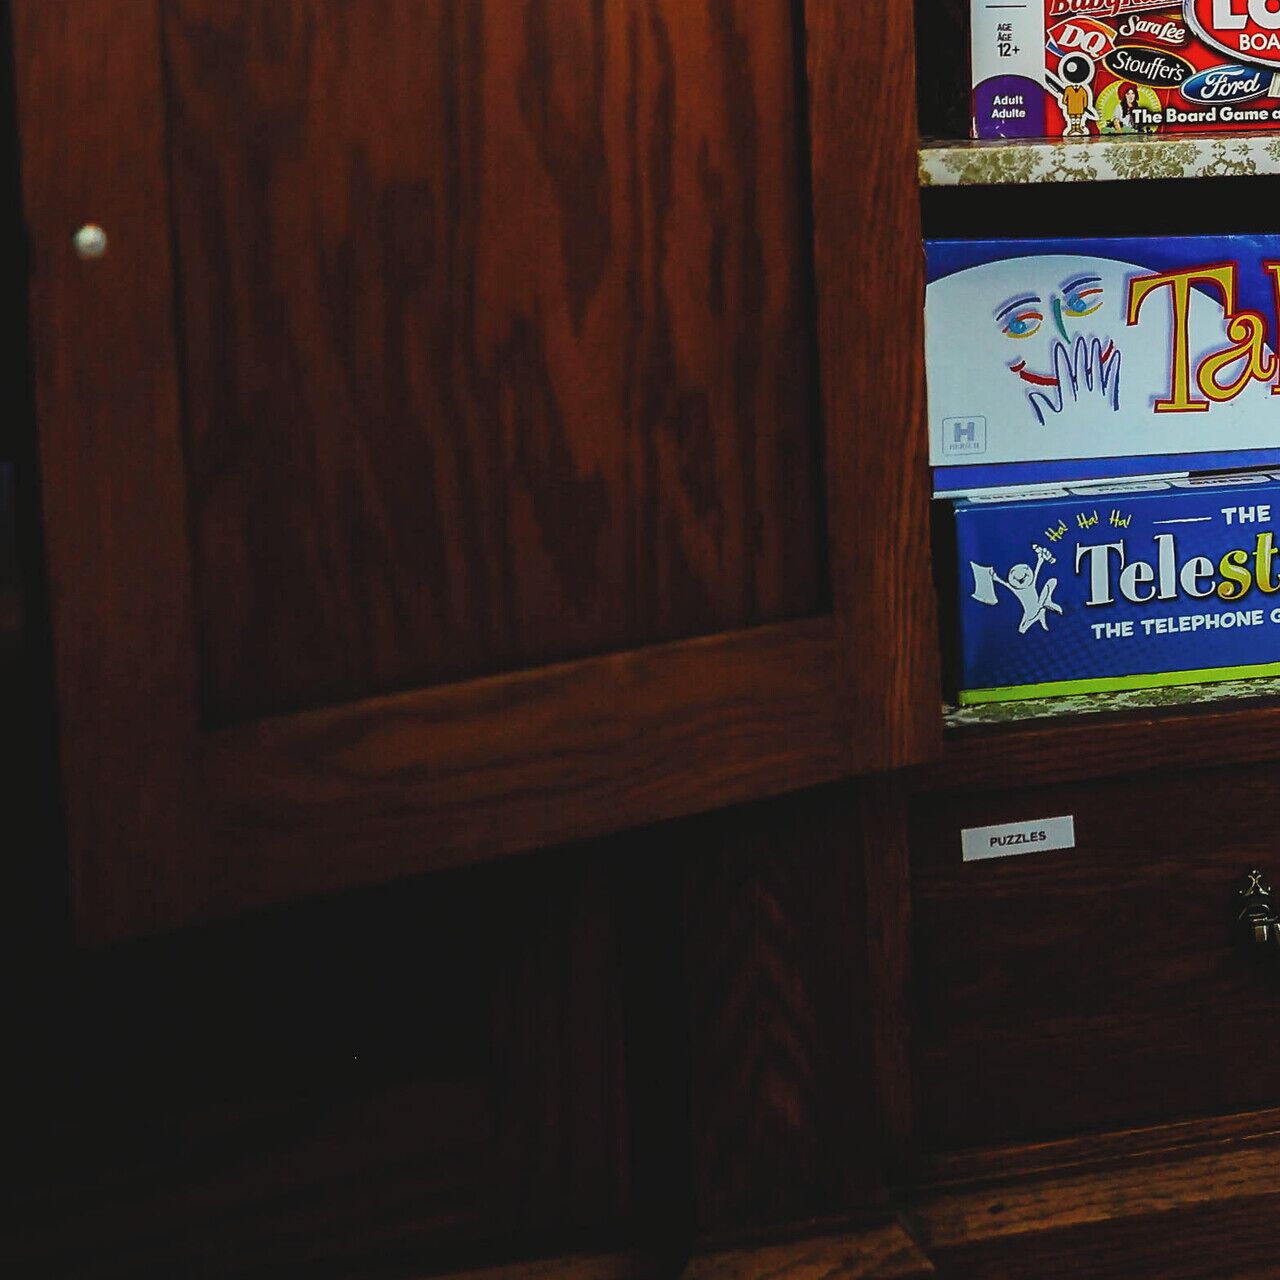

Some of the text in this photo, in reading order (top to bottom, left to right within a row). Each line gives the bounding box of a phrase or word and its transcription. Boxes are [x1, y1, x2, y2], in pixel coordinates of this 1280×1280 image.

[997, 42, 1020, 57] 12+
[1057, 24, 1108, 58] DQ
[1112, 51, 1185, 81] Stouffer's
[1200, 69, 1261, 99] Ford
[993, 95, 1023, 106] Adult
[991, 108, 1026, 119] Adulte
[1132, 108, 1162, 124] The
[1166, 107, 1216, 123] Board
[1219, 106, 1267, 121] Game
[1221, 504, 1275, 525] THE
[1044, 509, 1132, 542] Ha! Ha! Ha!
[1091, 620, 1135, 640] THE
[1140, 611, 1265, 636] TELEPHONE
[989, 830, 1047, 848] PUZZLES
